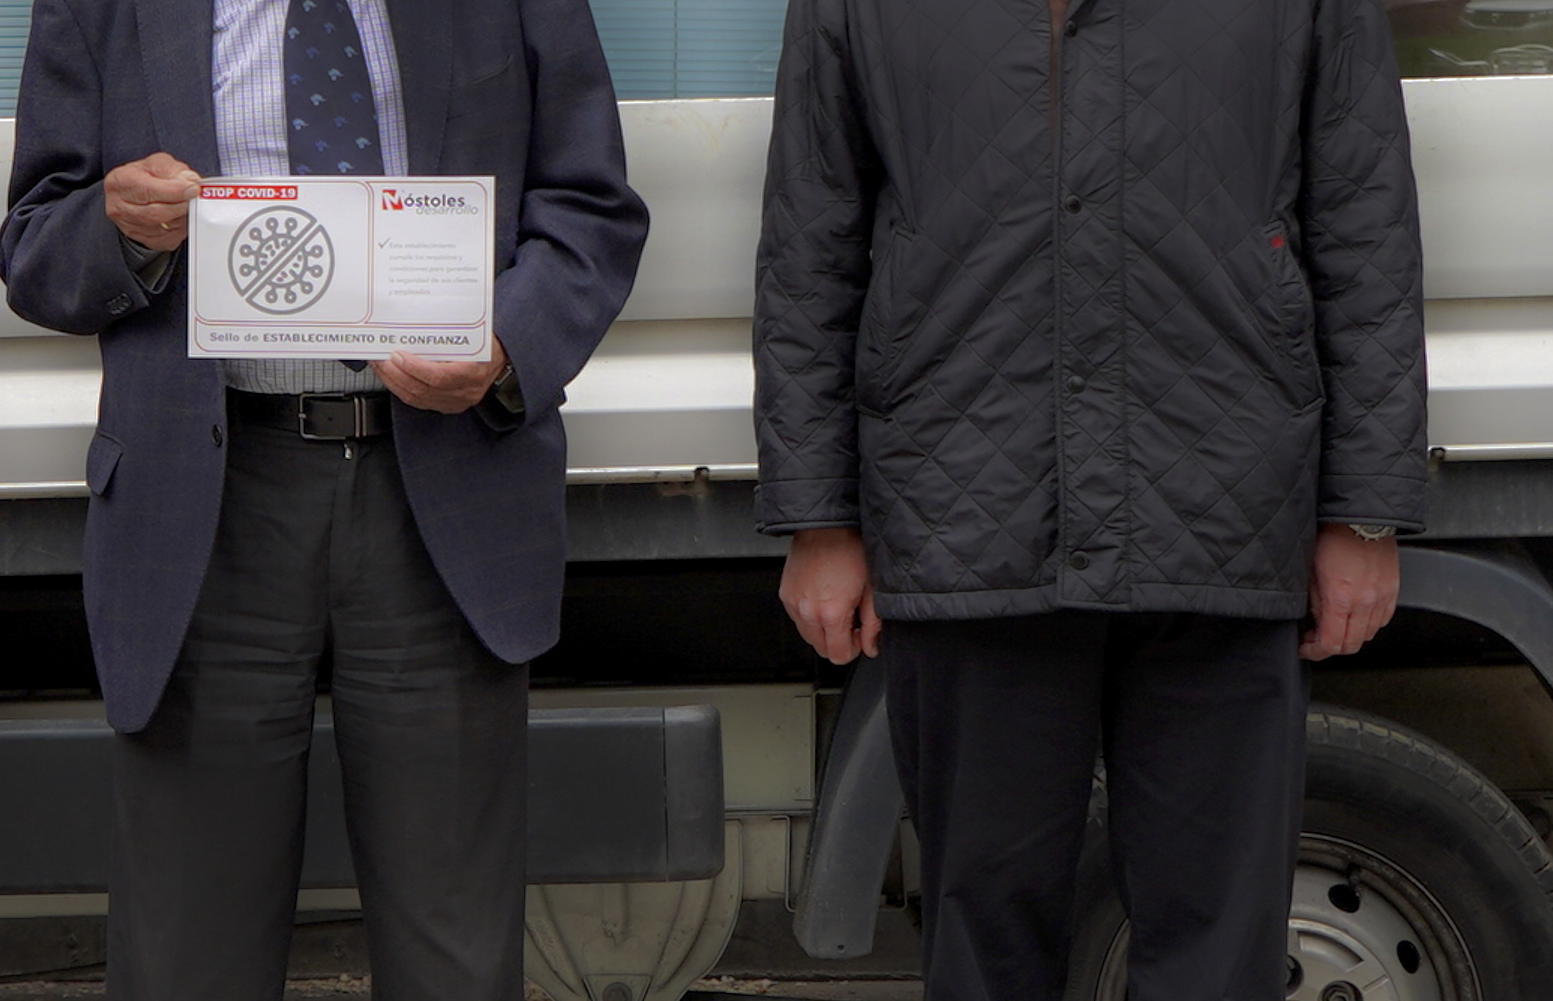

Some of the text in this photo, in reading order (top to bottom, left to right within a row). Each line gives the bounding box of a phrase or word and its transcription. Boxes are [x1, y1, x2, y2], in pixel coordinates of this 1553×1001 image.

[203, 187, 296, 198] STOP COVID-19
[210, 332, 470, 346] Sello de ESTABLECIMIENTO DE CONFIANZA
